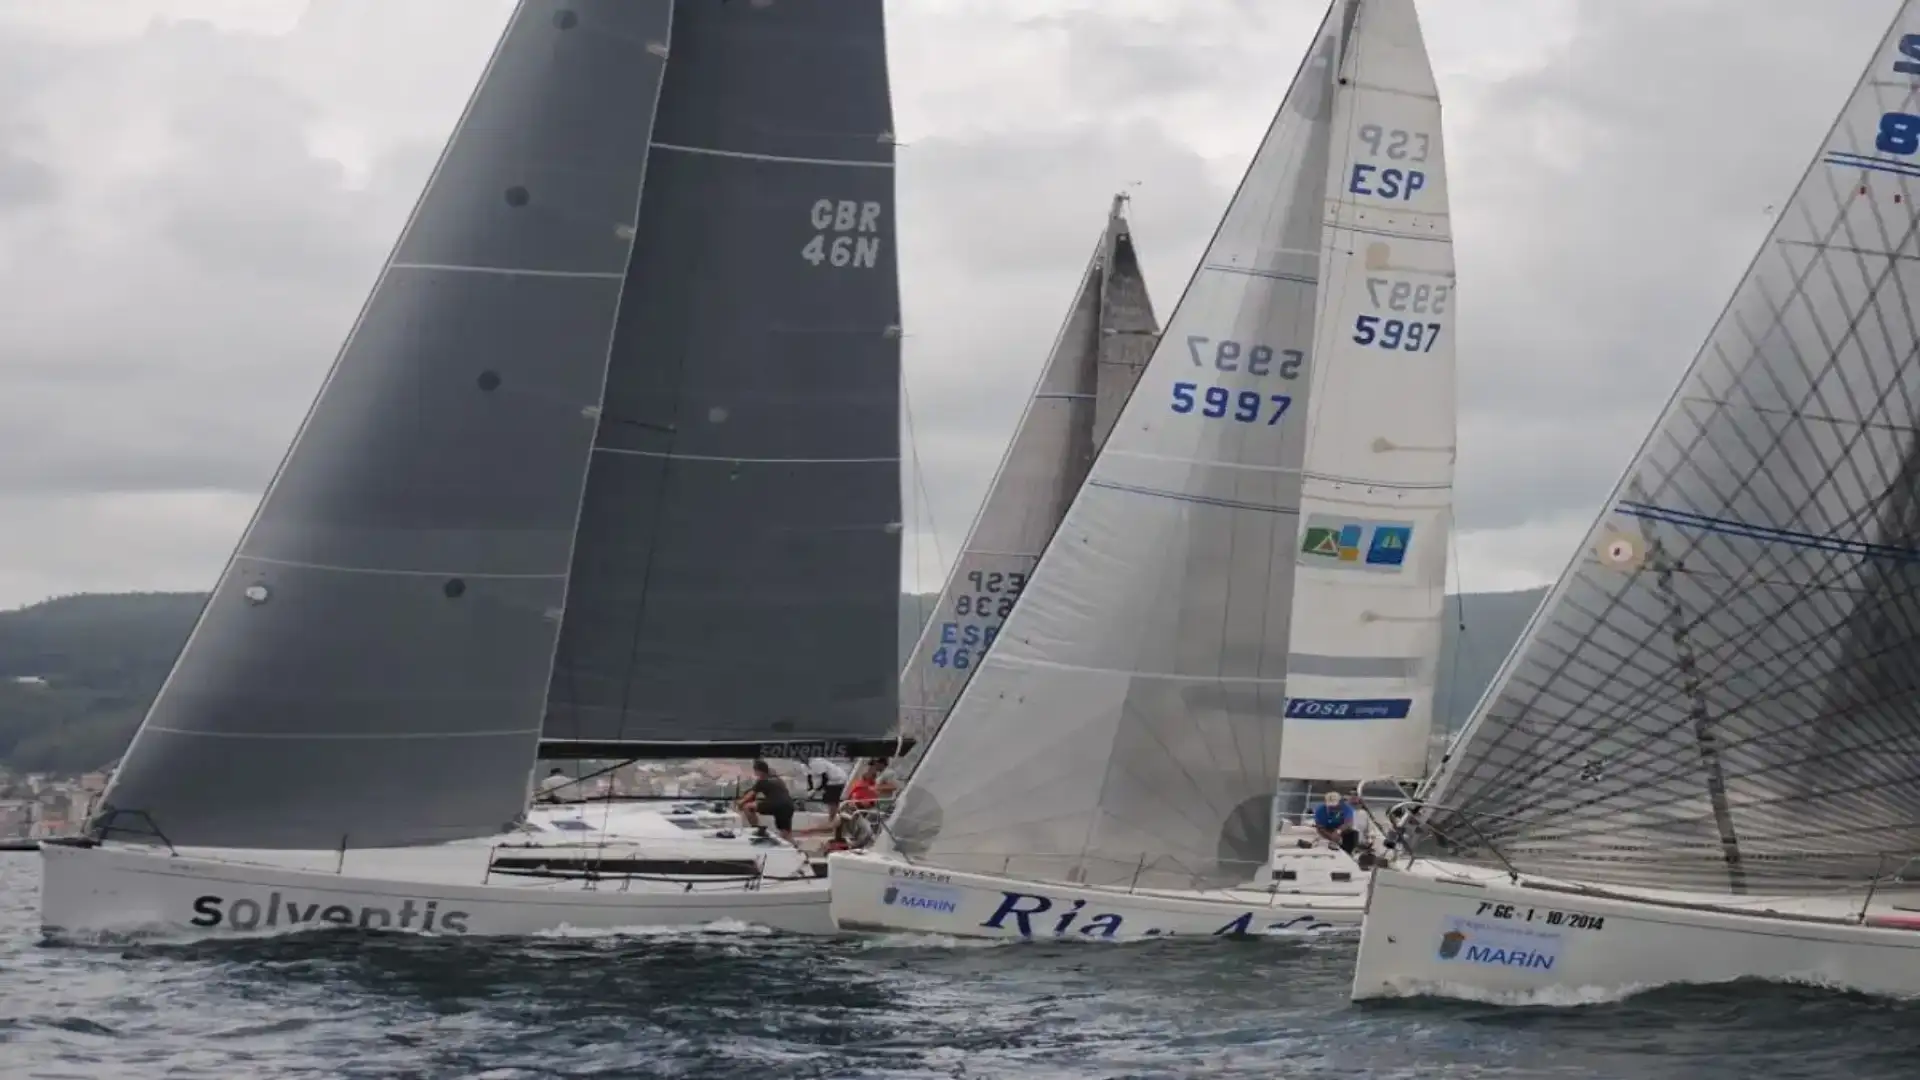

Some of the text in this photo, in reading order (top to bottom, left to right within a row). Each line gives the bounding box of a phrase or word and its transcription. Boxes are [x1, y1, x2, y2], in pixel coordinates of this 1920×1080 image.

[1349, 163, 1425, 201] ESP
[811, 198, 881, 232] GBR
[802, 234, 880, 268] 46N
[1353, 314, 1441, 353] 5997
[1171, 381, 1292, 426] 5997
[190, 891, 470, 933] solventis
[979, 891, 1123, 938] Ria
[1546, 910, 1605, 930] 10/2014
